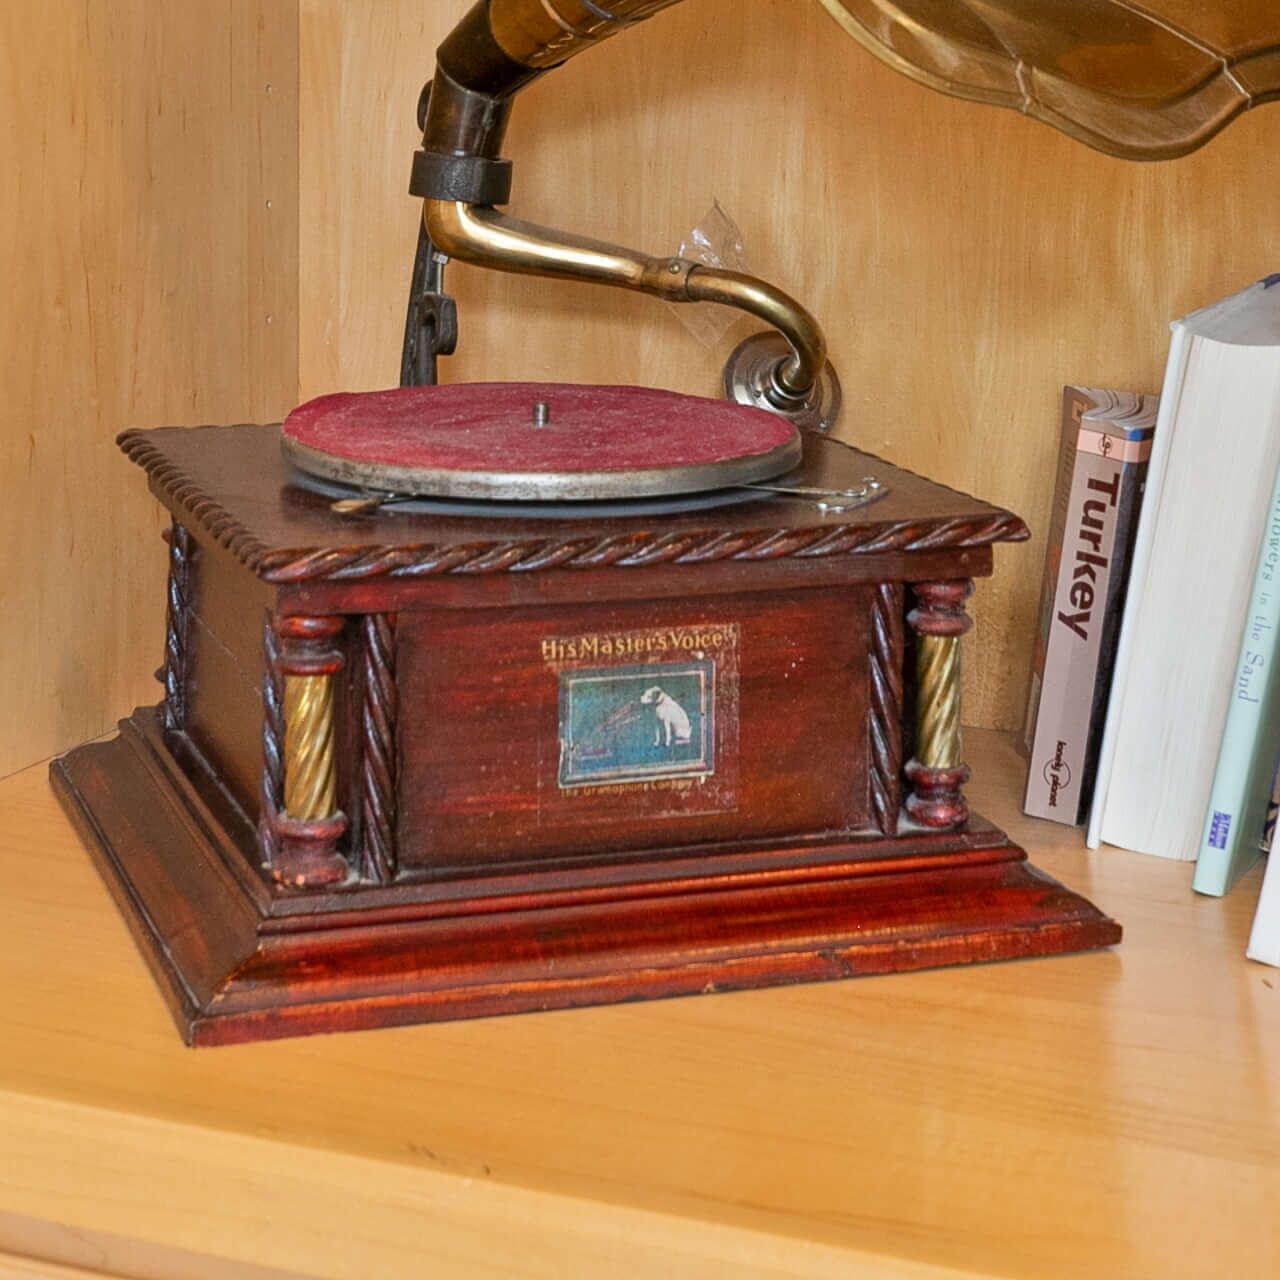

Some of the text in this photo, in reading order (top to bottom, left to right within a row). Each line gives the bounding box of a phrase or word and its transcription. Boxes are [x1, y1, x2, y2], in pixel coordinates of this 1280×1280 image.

[1057, 472, 1120, 642] Turkey
[1259, 591, 1273, 606] in
[1252, 614, 1274, 641] the
[1236, 650, 1265, 704] Sand
[1048, 740, 1068, 808] lonely planet
